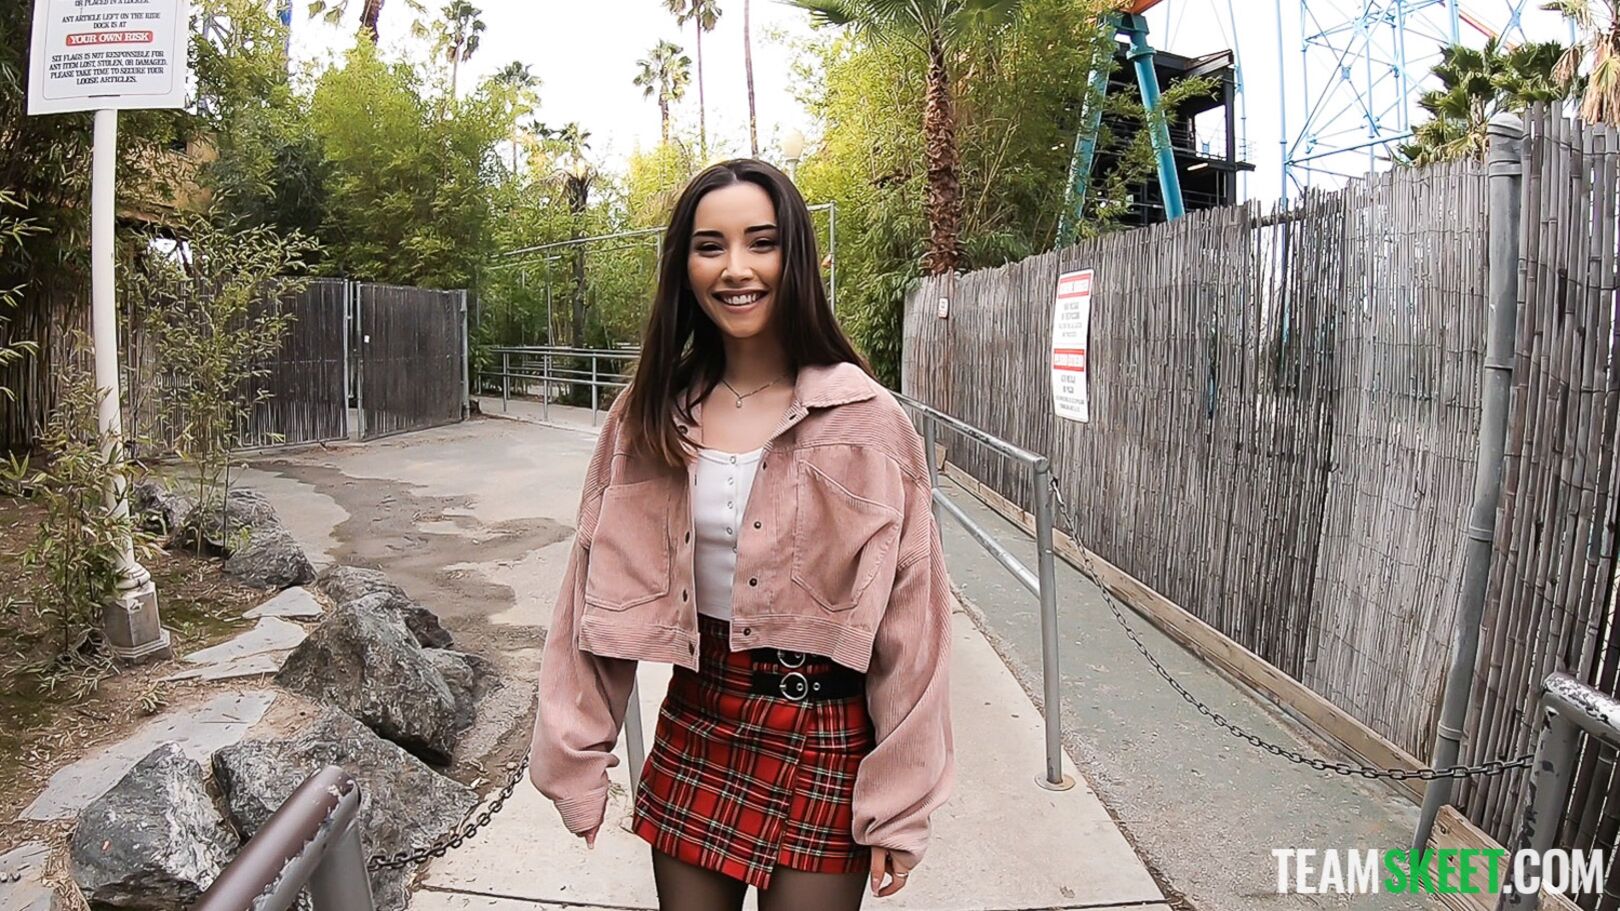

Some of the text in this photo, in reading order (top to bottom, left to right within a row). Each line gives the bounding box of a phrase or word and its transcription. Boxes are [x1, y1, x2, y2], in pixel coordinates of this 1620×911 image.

[62, 15, 74, 23] ANY
[75, 14, 101, 22] ARTICLE
[102, 13, 119, 21] LEFT
[69, 32, 149, 44] YOUR OWN RISK
[63, 53, 83, 62] FLAGS
[105, 50, 150, 58] RESPONSIBLE
[49, 63, 61, 71] ANY
[62, 61, 79, 70] ITEM
[50, 70, 74, 79] PLEASE
[75, 69, 92, 77] TAKE
[93, 68, 109, 76] TIME
[110, 67, 120, 75] TO
[147, 66, 164, 74] YOUR
[76, 77, 99, 85] LOOSE
